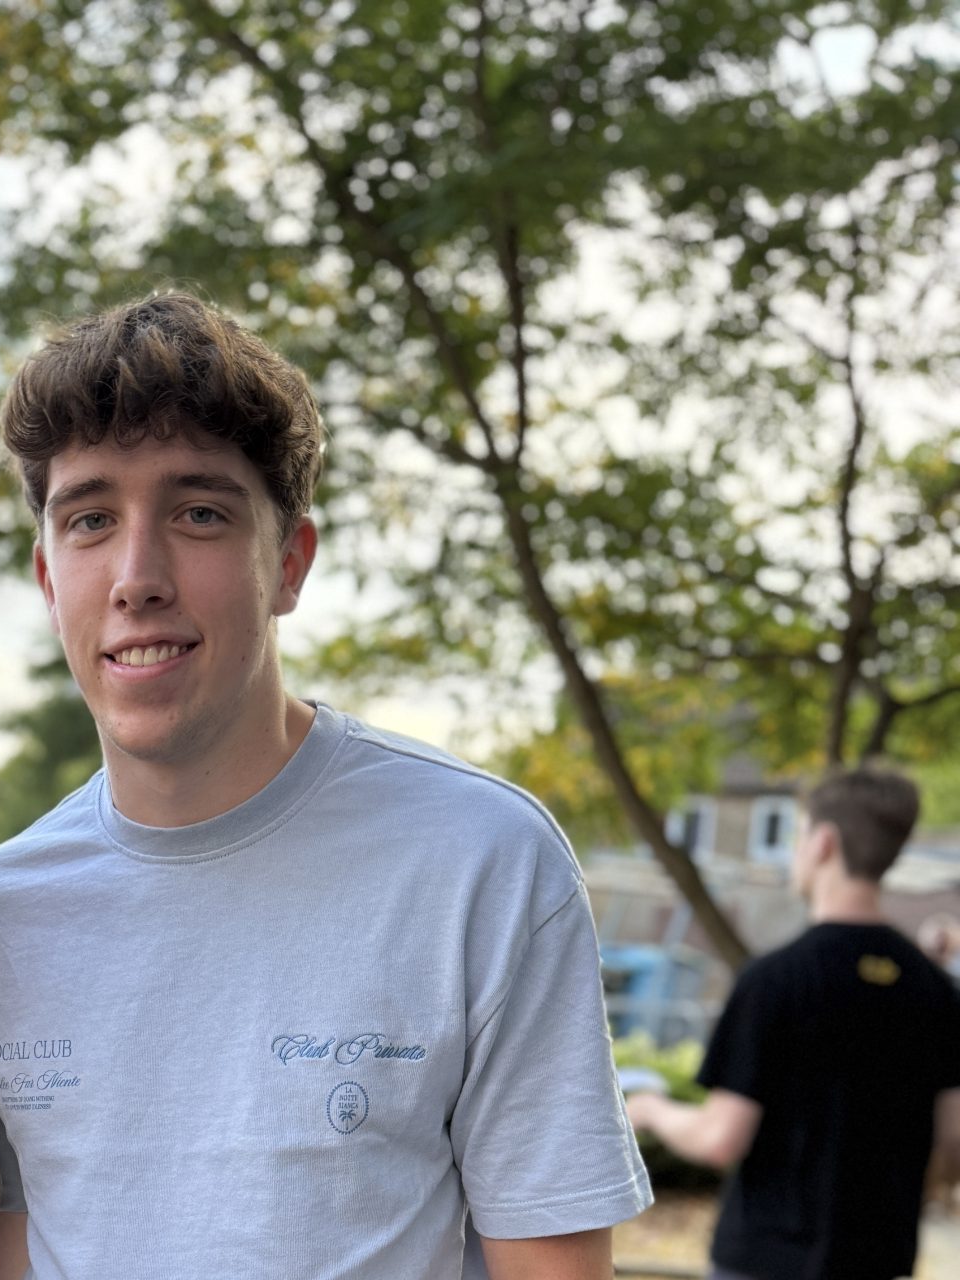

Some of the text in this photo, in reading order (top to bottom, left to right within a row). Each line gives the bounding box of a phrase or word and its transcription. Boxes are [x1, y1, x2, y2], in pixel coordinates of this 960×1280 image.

[33, 1039, 72, 1059] CLUB
[271, 1033, 336, 1065] Club
[11, 1072, 34, 1094] Far
[36, 1069, 81, 1090] Niente
[345, 1086, 353, 1094] LA
